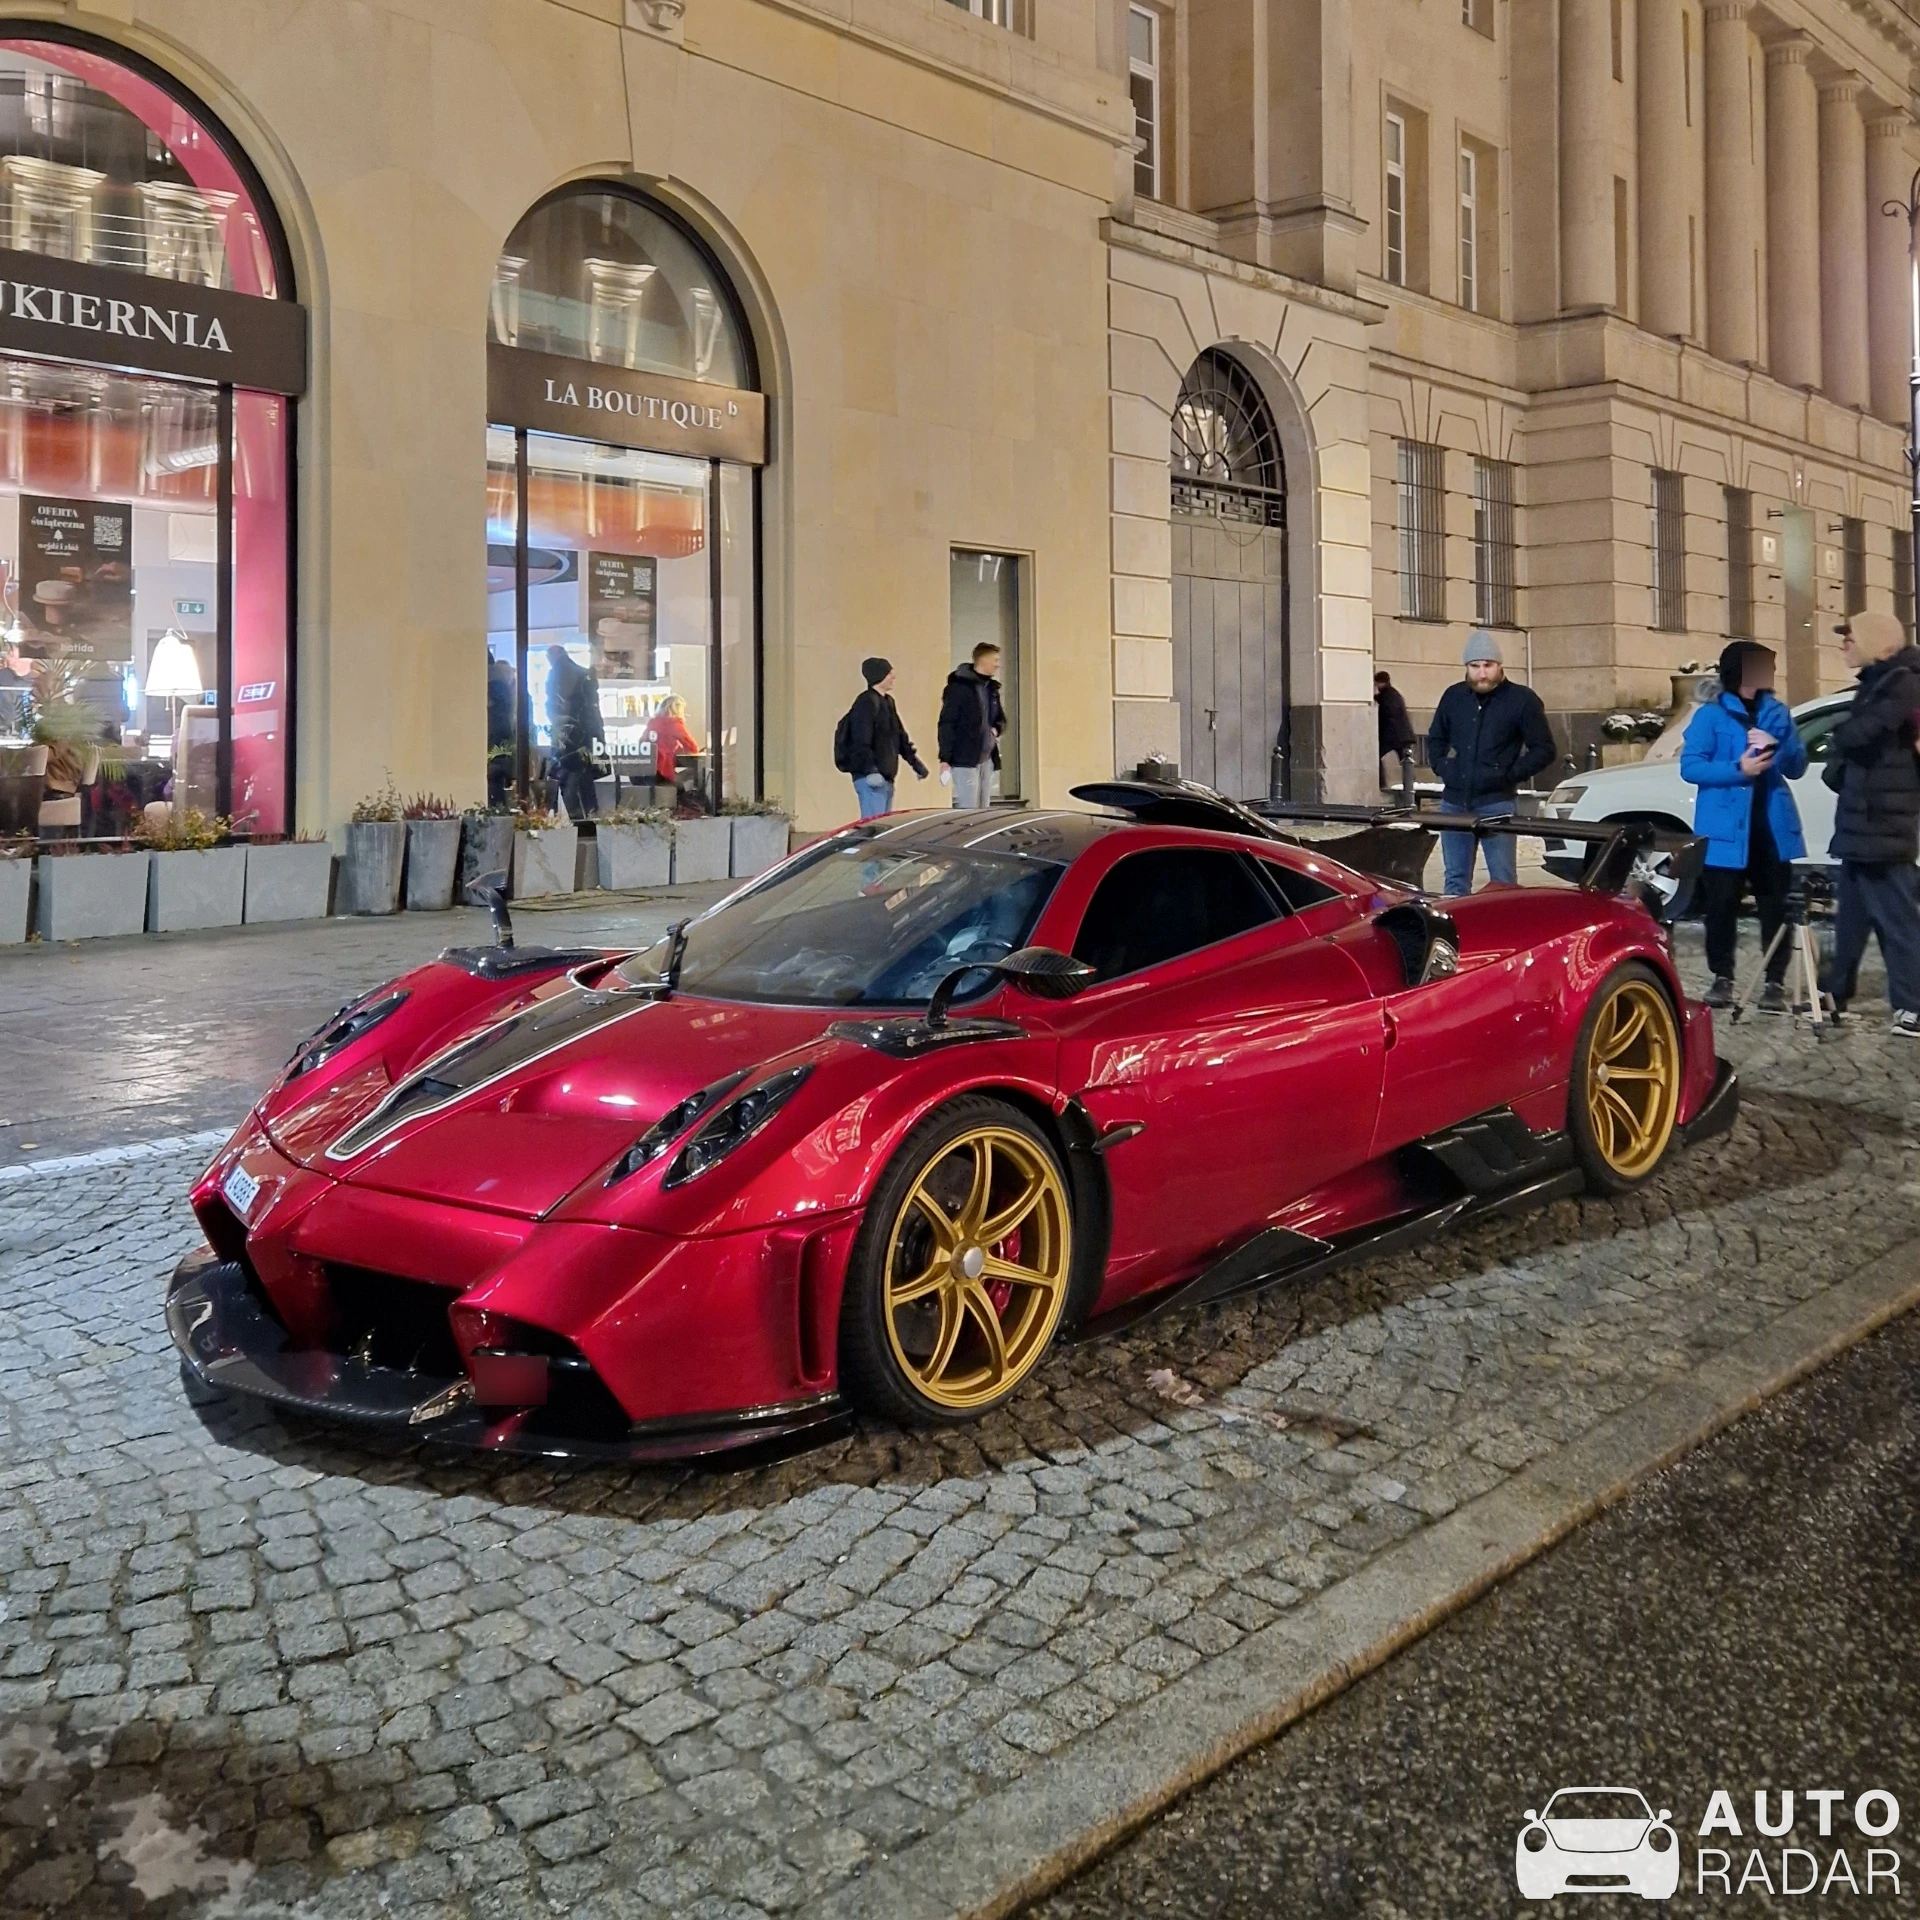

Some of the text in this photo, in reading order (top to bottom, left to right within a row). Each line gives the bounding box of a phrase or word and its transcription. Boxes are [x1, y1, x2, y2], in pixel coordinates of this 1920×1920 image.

[0, 280, 232, 352] KIERNIA
[544, 378, 580, 406] LA
[587, 386, 723, 430] BOUTIQUE
[37, 506, 79, 518] OFERTA
